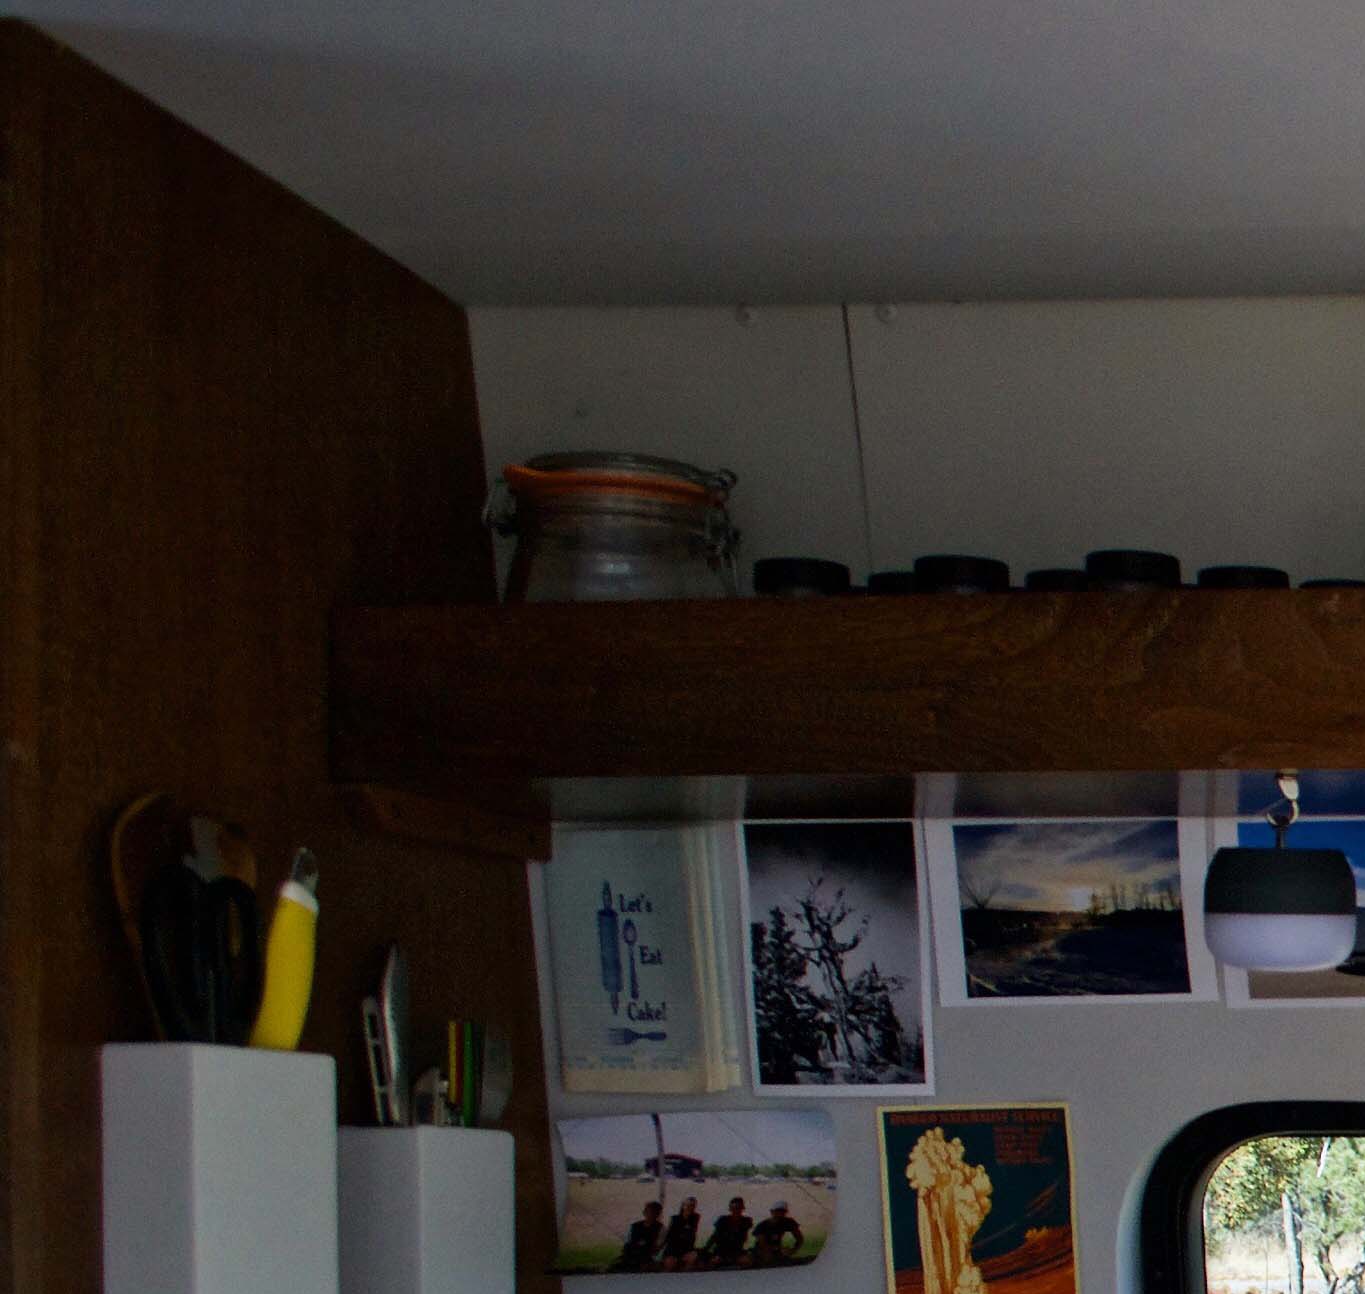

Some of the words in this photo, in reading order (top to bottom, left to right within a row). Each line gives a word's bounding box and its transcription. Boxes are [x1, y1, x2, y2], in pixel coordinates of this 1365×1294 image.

[619, 893, 652, 912] Let's
[639, 945, 663, 964] Eat
[627, 1002, 668, 1021] Cake!
